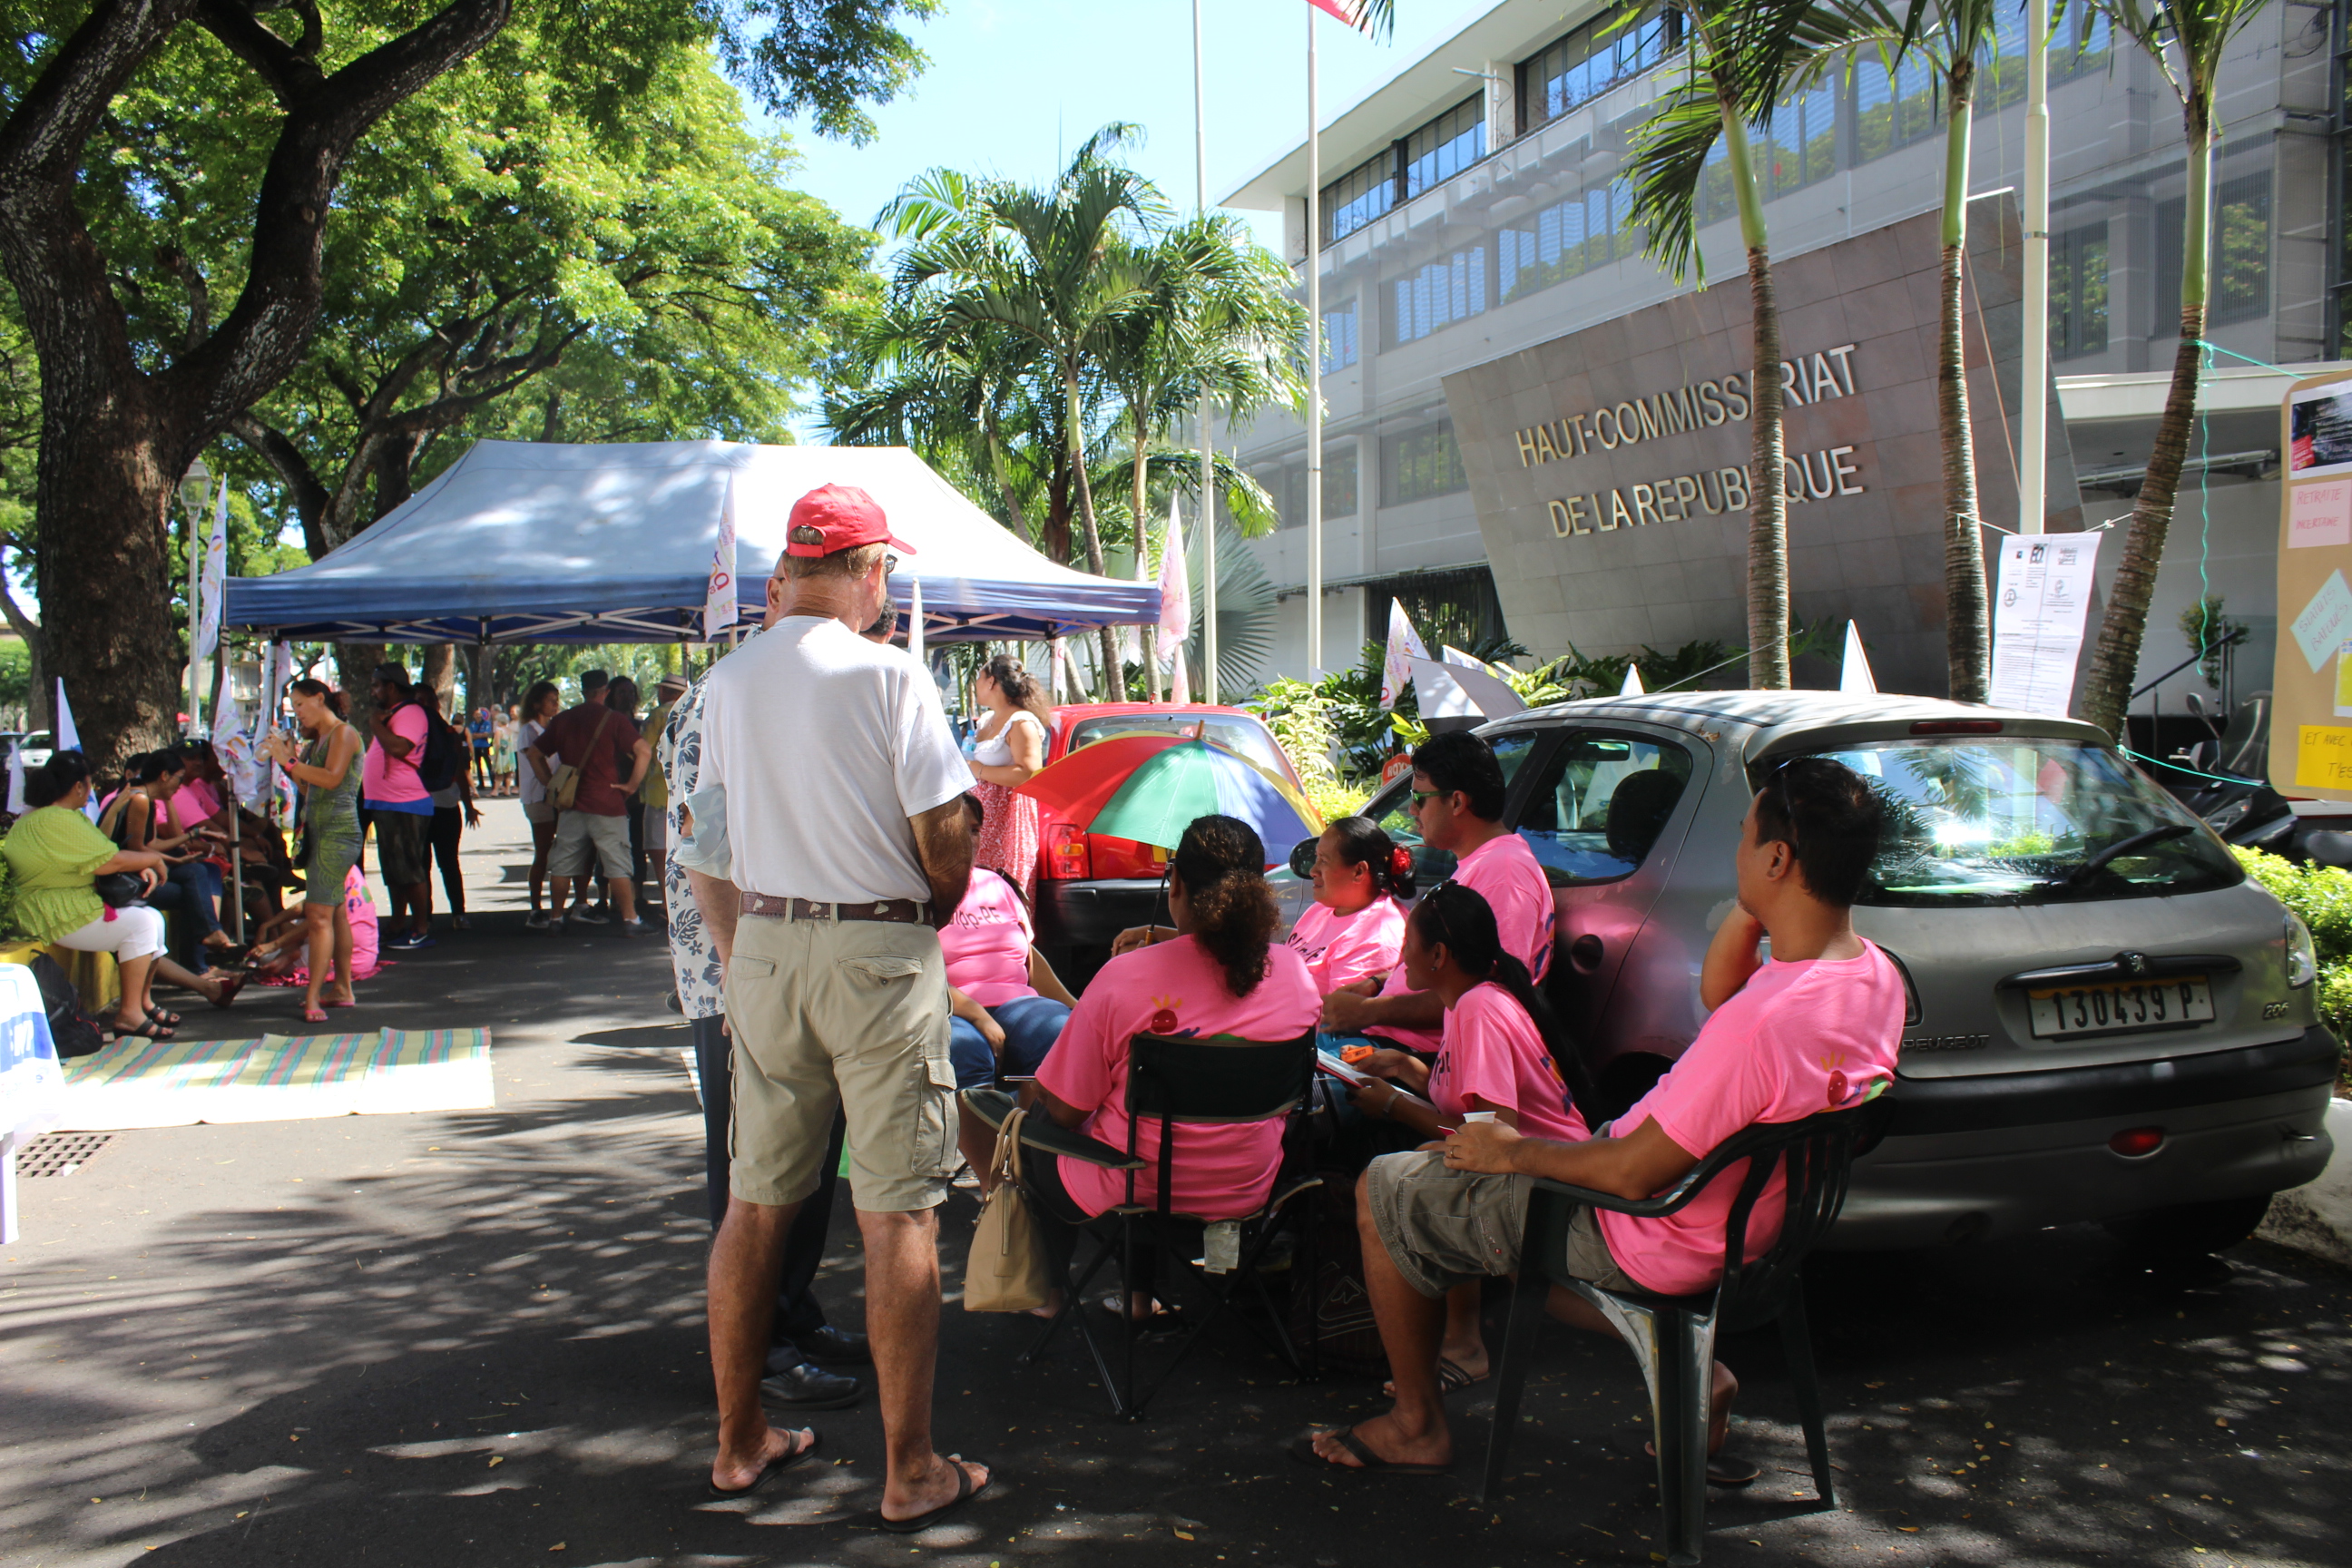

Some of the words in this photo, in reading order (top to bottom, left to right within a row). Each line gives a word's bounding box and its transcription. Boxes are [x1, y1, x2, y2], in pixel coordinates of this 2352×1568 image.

[1515, 343, 1857, 467] HAUT-COMMISSRIAT
[1548, 495, 1592, 539] DE
[1591, 488, 1634, 532] LA
[1632, 445, 1865, 526] REPUBQUE
[2297, 487, 2343, 505] RETRAITE
[2305, 731, 2322, 746] ET
[2323, 734, 2346, 747] AVEC
[2053, 985, 2166, 1030] 130439
[2178, 982, 2192, 1019] P
[2264, 1002, 2289, 1018] 206
[1902, 1034, 1990, 1052] PEUGEOT
